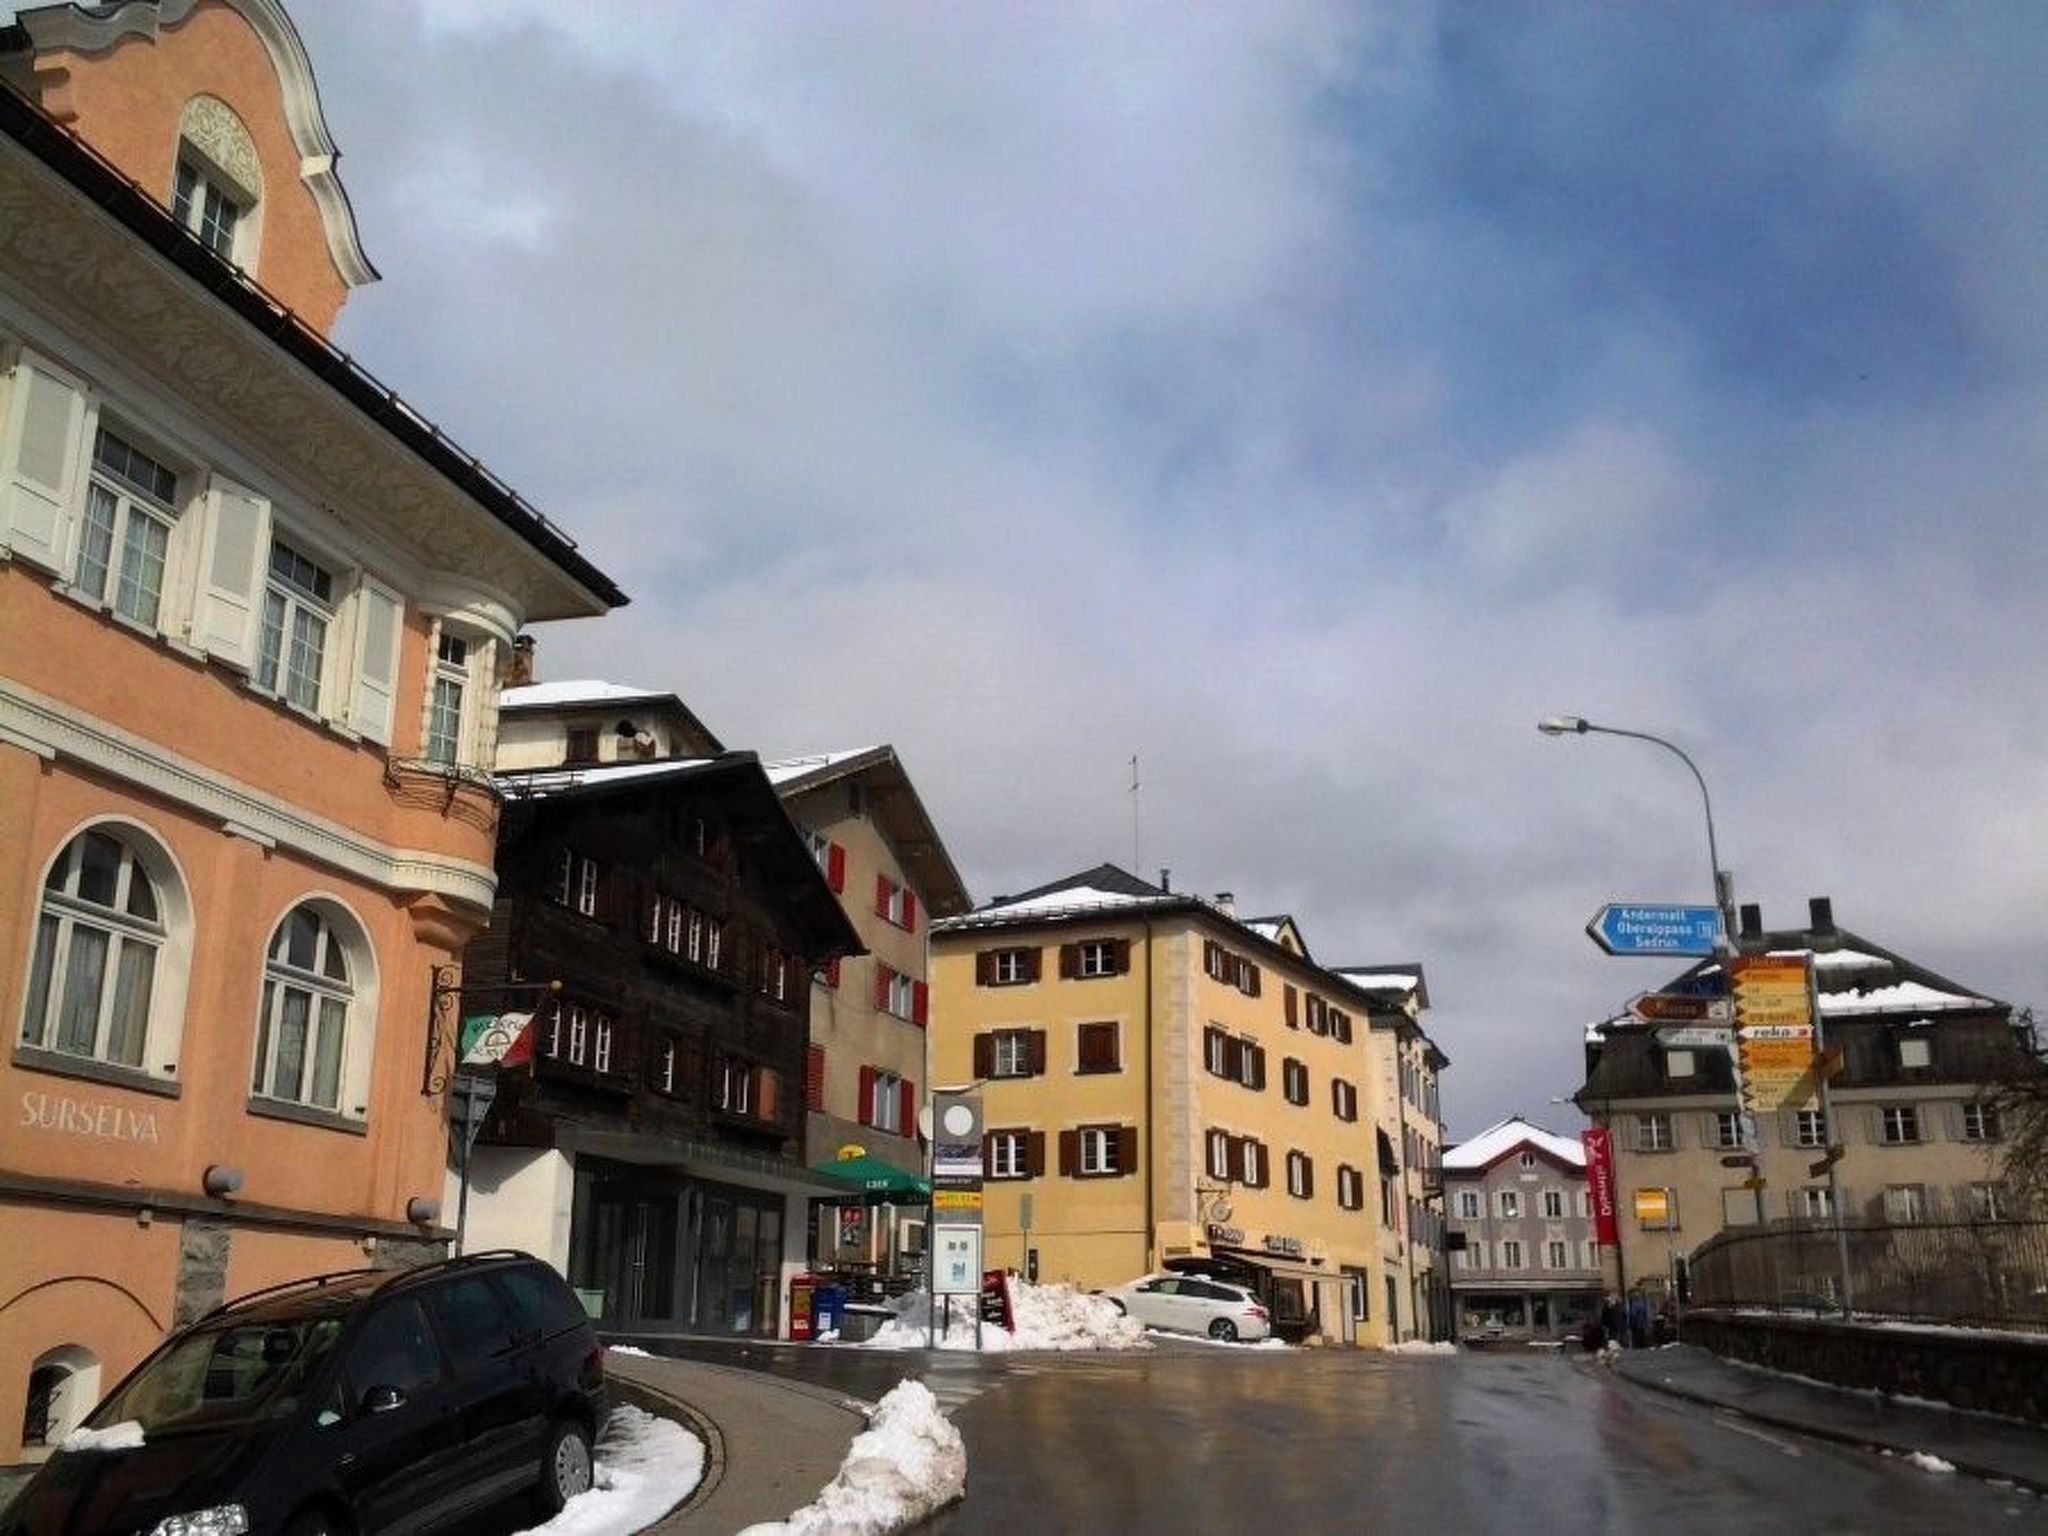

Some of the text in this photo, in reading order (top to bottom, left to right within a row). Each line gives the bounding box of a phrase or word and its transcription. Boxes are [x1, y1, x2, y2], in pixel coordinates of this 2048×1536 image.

[1621, 909, 1686, 922] Andermatt
[1617, 923, 1692, 937] Oberalppass
[1636, 936, 1678, 948] Sedrun
[21, 1092, 159, 1144] SURSELVA
